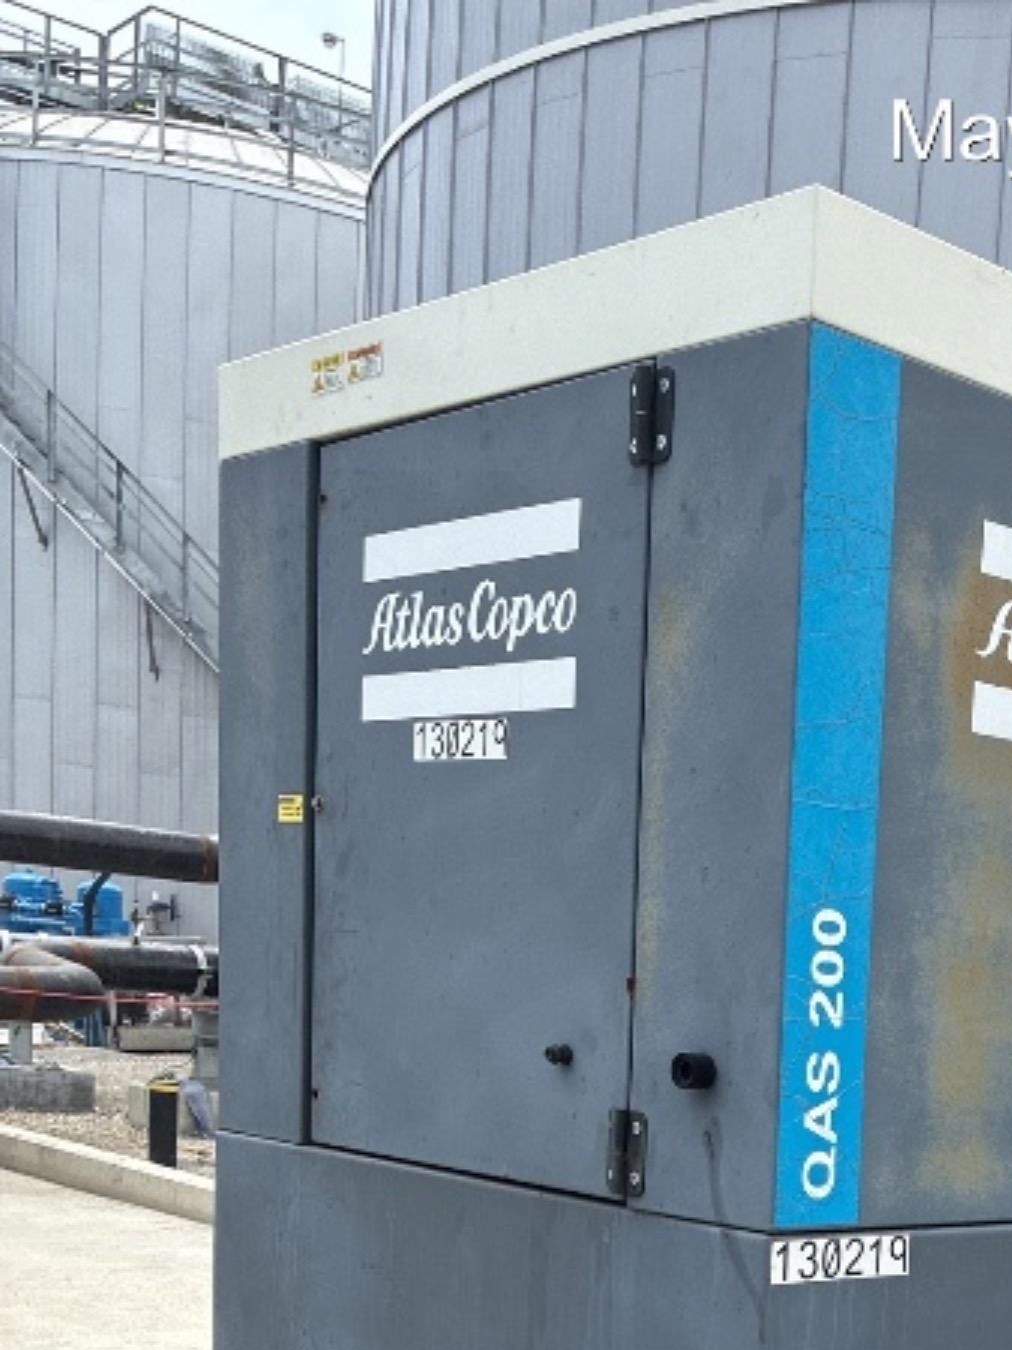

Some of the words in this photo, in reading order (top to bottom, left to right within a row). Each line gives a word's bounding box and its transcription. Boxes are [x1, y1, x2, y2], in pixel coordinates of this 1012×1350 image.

[414, 719, 508, 760] 130219
[809, 908, 848, 1030] 200
[802, 1050, 842, 1200] QAS
[774, 1235, 908, 1282] 130219
